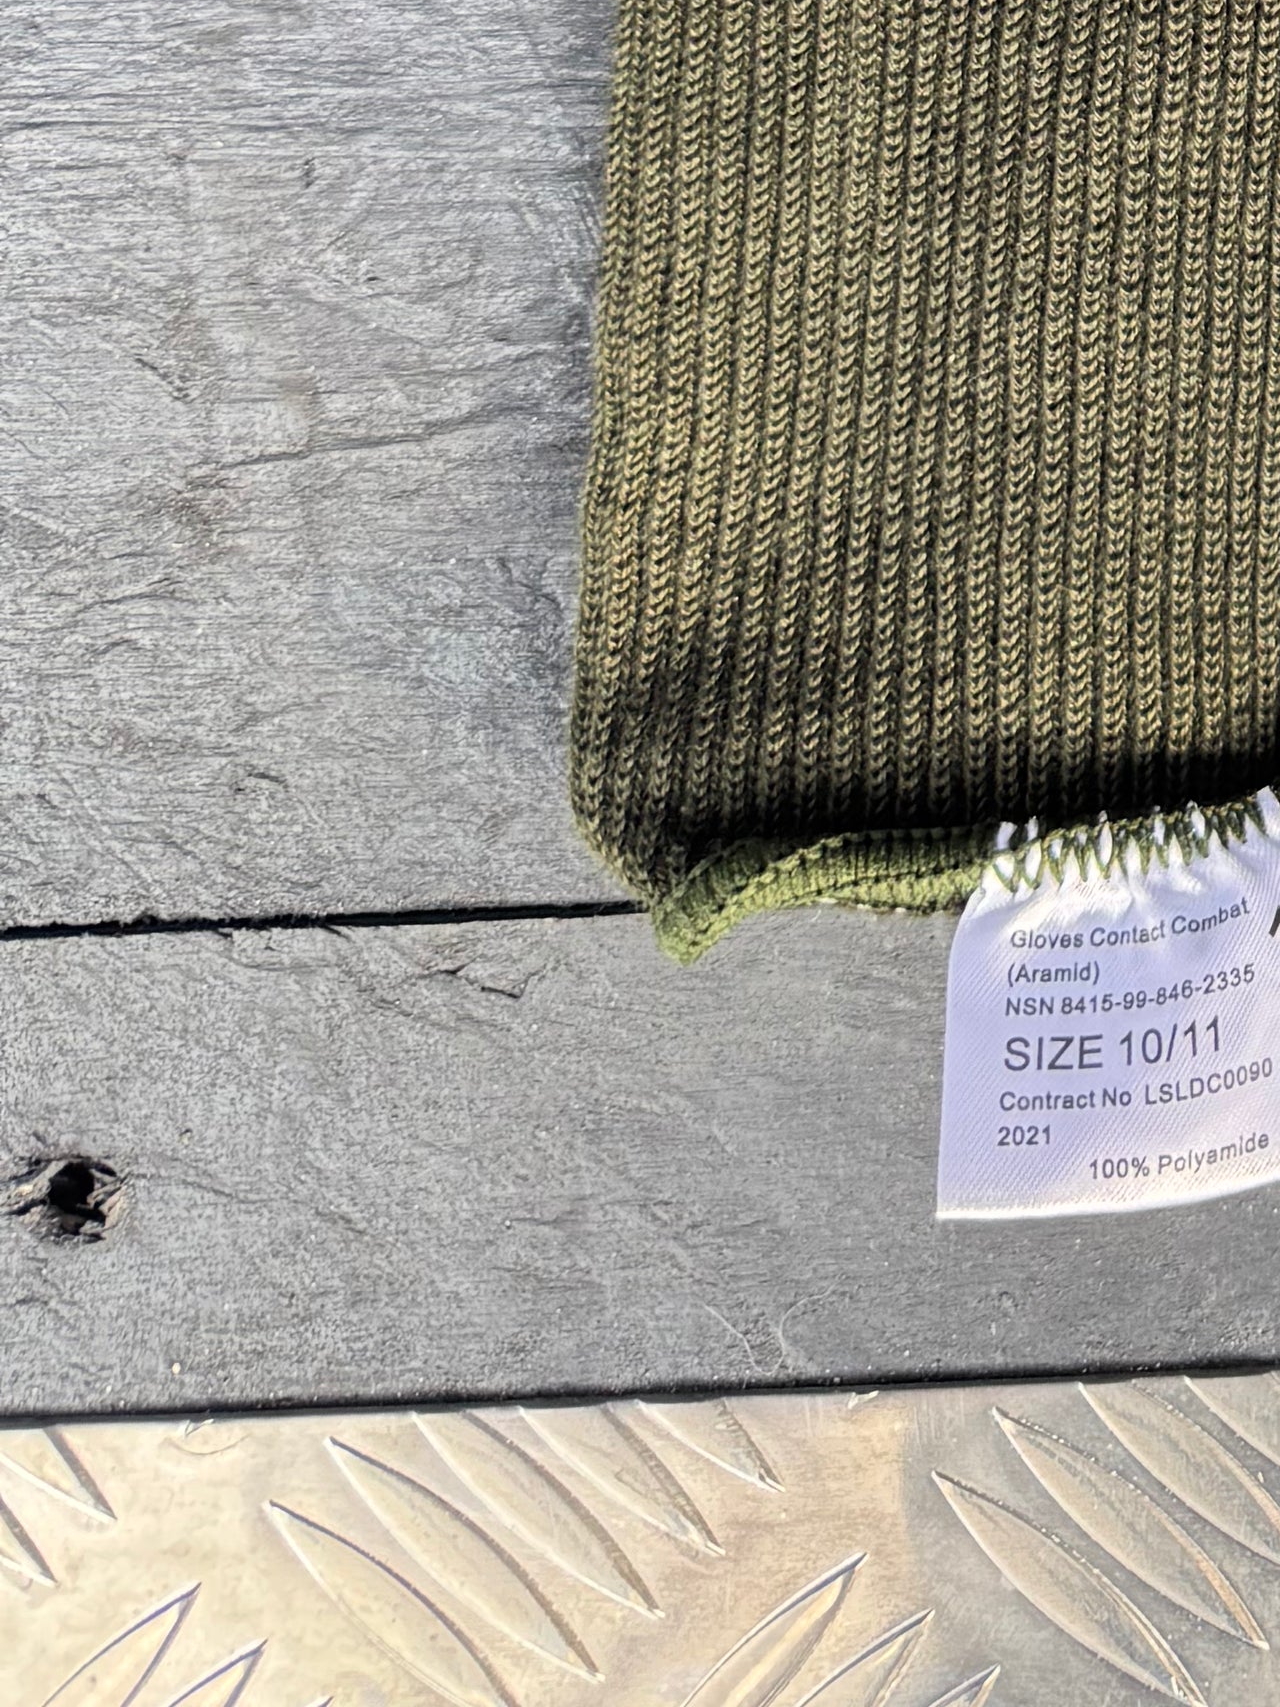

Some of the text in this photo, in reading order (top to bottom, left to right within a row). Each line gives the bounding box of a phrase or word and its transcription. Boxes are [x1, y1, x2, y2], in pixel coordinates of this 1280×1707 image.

[1010, 897, 1250, 949] Gloves Contact Combat
[1005, 963, 1256, 1017] NSN 8415-99-846-2335
[1006, 961, 1101, 987] (Aramid)
[1004, 1015, 1222, 1071] SIZE 10/11
[1000, 1057, 1273, 1112] Contract No LSLDC0090
[997, 1124, 1051, 1147] 2021
[1089, 1131, 1270, 1180] 100% Polyamide
